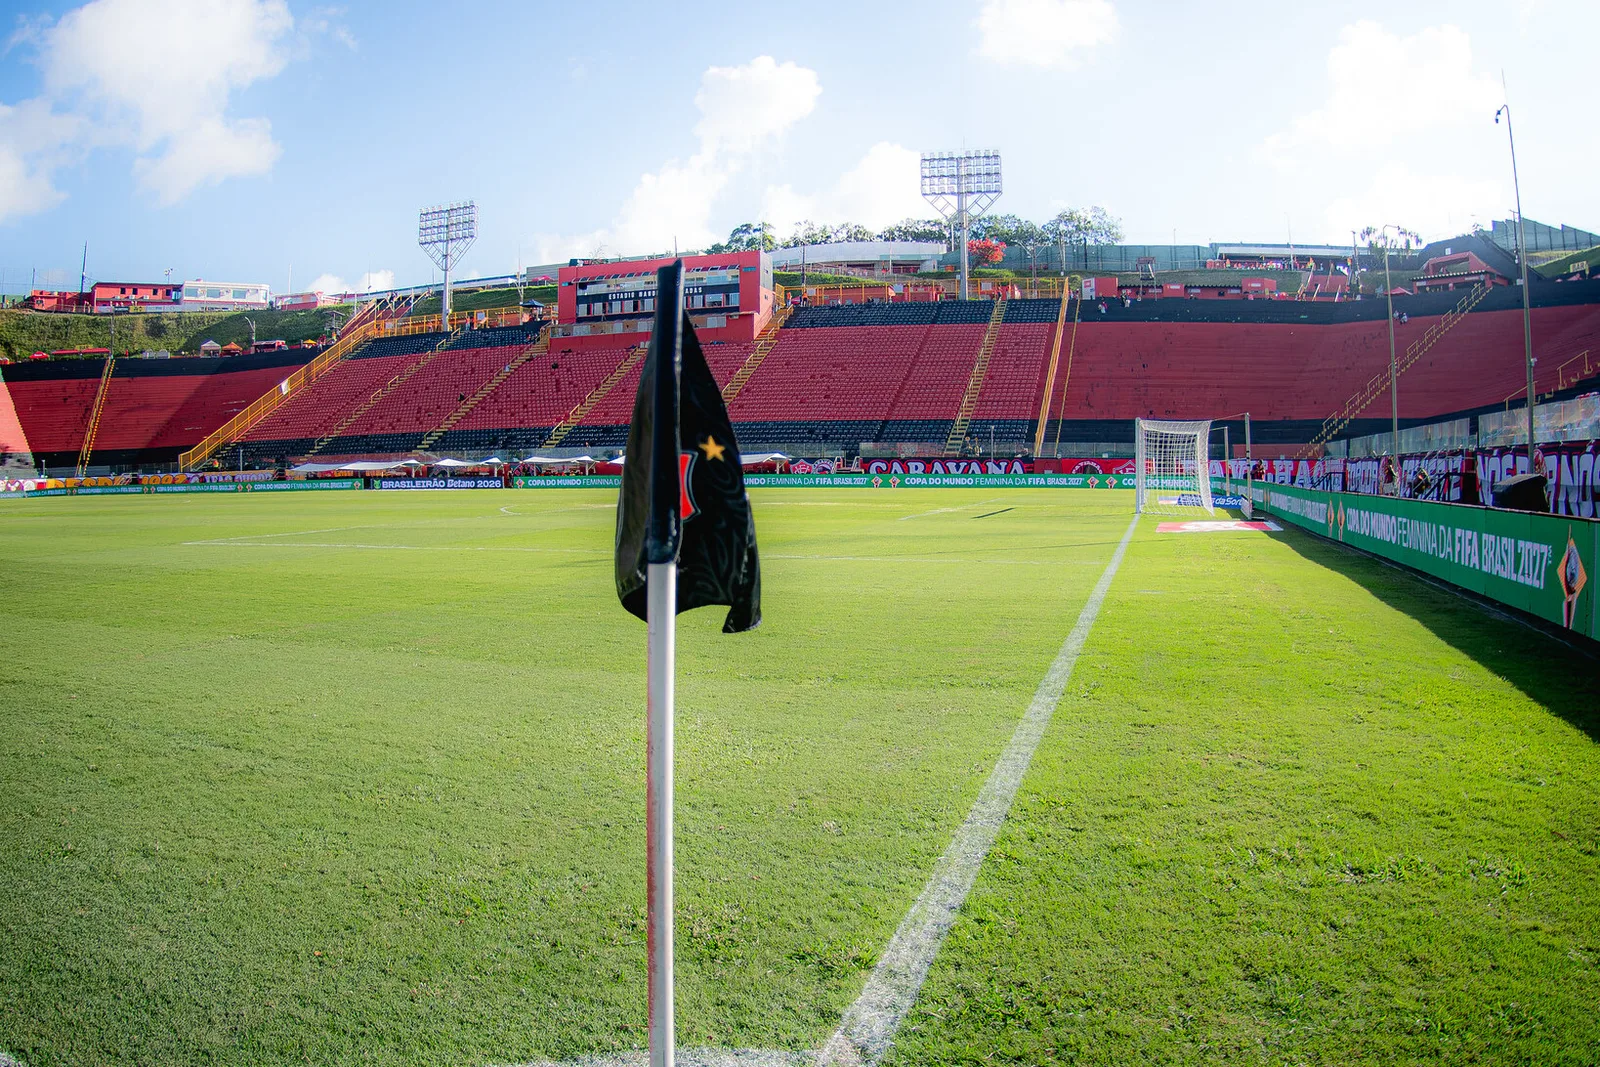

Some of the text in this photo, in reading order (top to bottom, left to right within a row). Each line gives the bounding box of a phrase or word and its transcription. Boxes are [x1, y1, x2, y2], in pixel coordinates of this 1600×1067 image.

[869, 461, 1025, 474] CARAVANA
[382, 478, 501, 488] BRASILEIRÃO Betano 2026
[557, 478, 581, 486] MUNDO
[767, 477, 802, 485] FEMININA
[804, 477, 814, 485] DA
[816, 477, 832, 485] FIFA
[834, 477, 853, 485] BRASIL
[905, 477, 927, 485] COPA
[929, 477, 940, 485] DO
[943, 477, 973, 485] MUNDO
[975, 477, 1013, 485] FEMININA
[1014, 477, 1027, 486] DA
[1028, 477, 1046, 486] FIFA
[1047, 478, 1067, 486] BRASIL
[1346, 508, 1360, 533] COPA
[1360, 510, 1370, 536] DO
[1370, 512, 1397, 544] MUNDO
[1397, 517, 1437, 556] FEMININA
[1439, 525, 1453, 562] DA
[1454, 528, 1480, 570] FIFA
[1482, 533, 1517, 582] BRASIL
[1517, 540, 1549, 590] 2027
